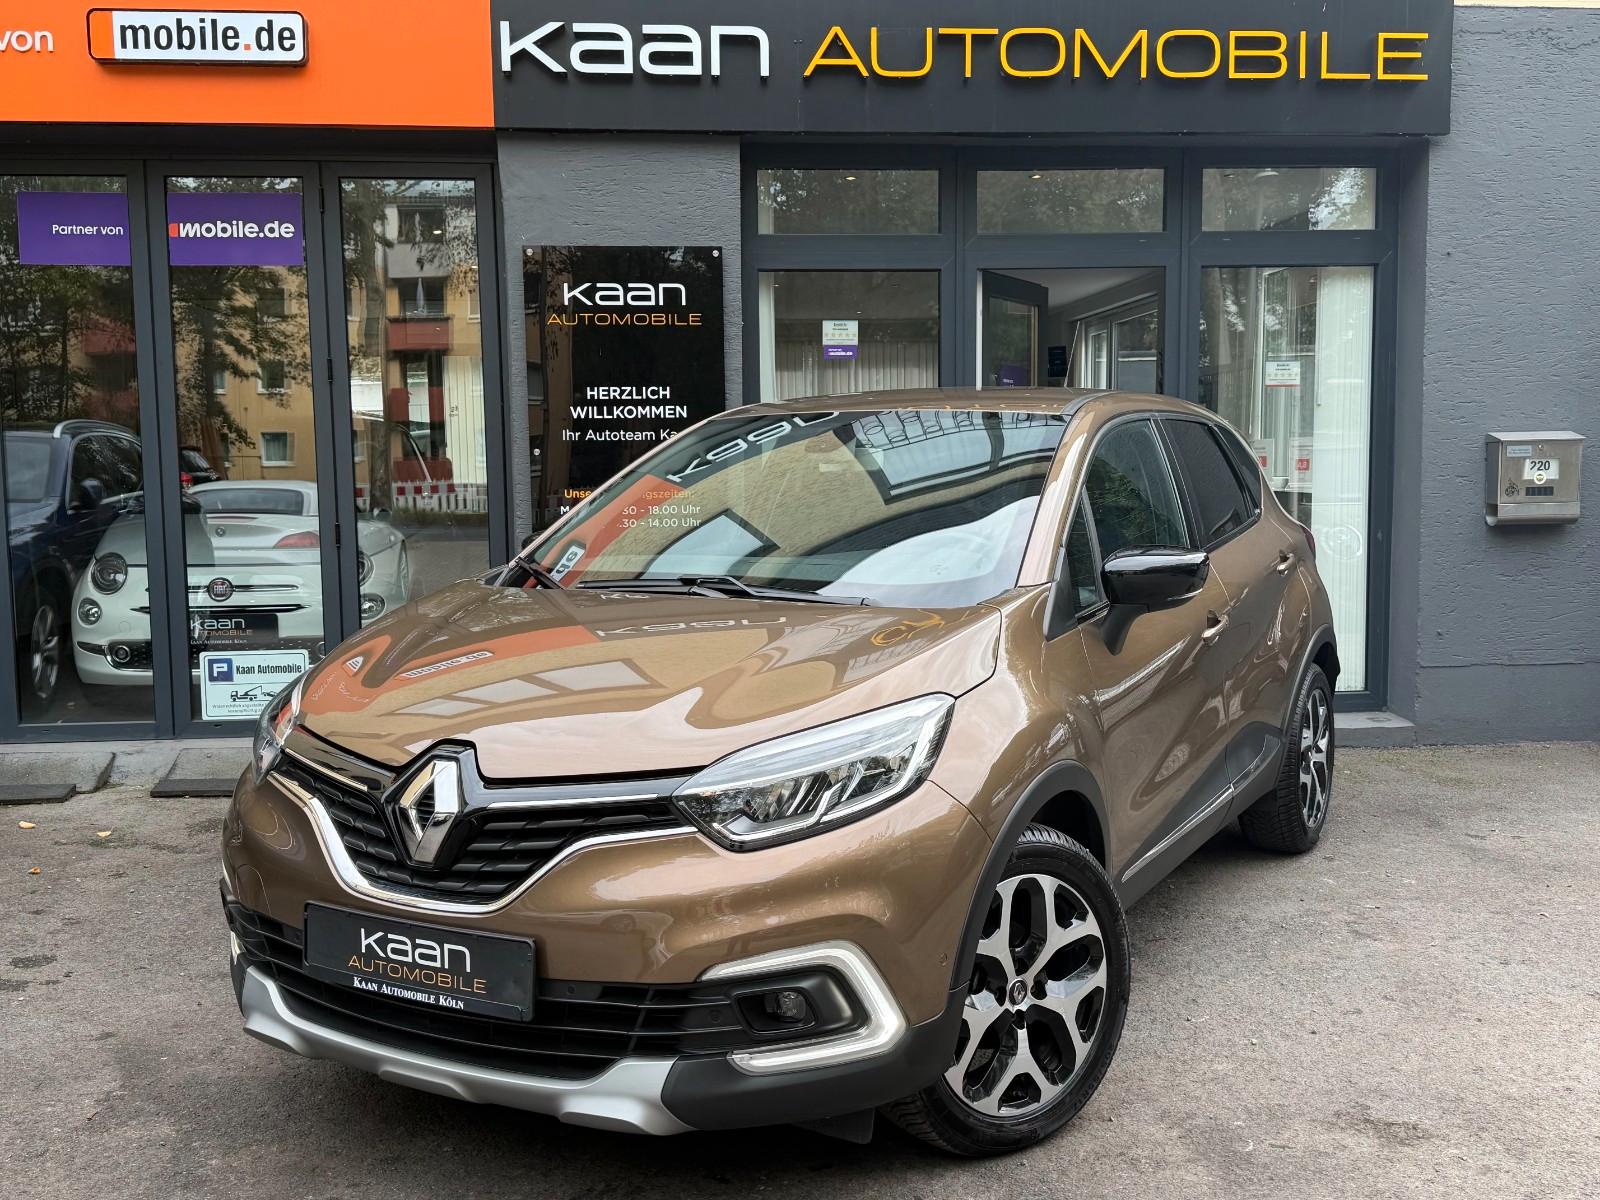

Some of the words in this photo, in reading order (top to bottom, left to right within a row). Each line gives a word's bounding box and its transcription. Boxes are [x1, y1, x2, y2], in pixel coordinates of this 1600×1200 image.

[119, 17, 297, 52] mobile.de
[803, 26, 1429, 81] AUTOMOBILE
[52, 223, 98, 235] Partner
[100, 225, 124, 236] von
[179, 220, 295, 239] mobile.de
[547, 313, 703, 326] AUTOMOBILE
[586, 386, 671, 400] HERZLICH
[570, 405, 688, 419] WILLKOMMEN
[562, 429, 581, 441] Ihr
[585, 429, 656, 441] Autoteam
[660, 429, 679, 441] Ka
[1529, 460, 1551, 471] 220
[564, 488, 592, 499] Unse
[648, 505, 678, 515] 18.00
[681, 504, 701, 514] Uhr
[648, 518, 678, 528] 14.00
[681, 518, 701, 528] Uhr
[213, 663, 228, 677] P
[236, 665, 256, 675] Kaan
[257, 663, 302, 675] Automobile
[348, 955, 487, 994] AUTOMOBILE
[353, 976, 378, 992] KAAN
[380, 981, 436, 1004] AUTOMOBILE
[439, 995, 465, 1010] KÖLN
